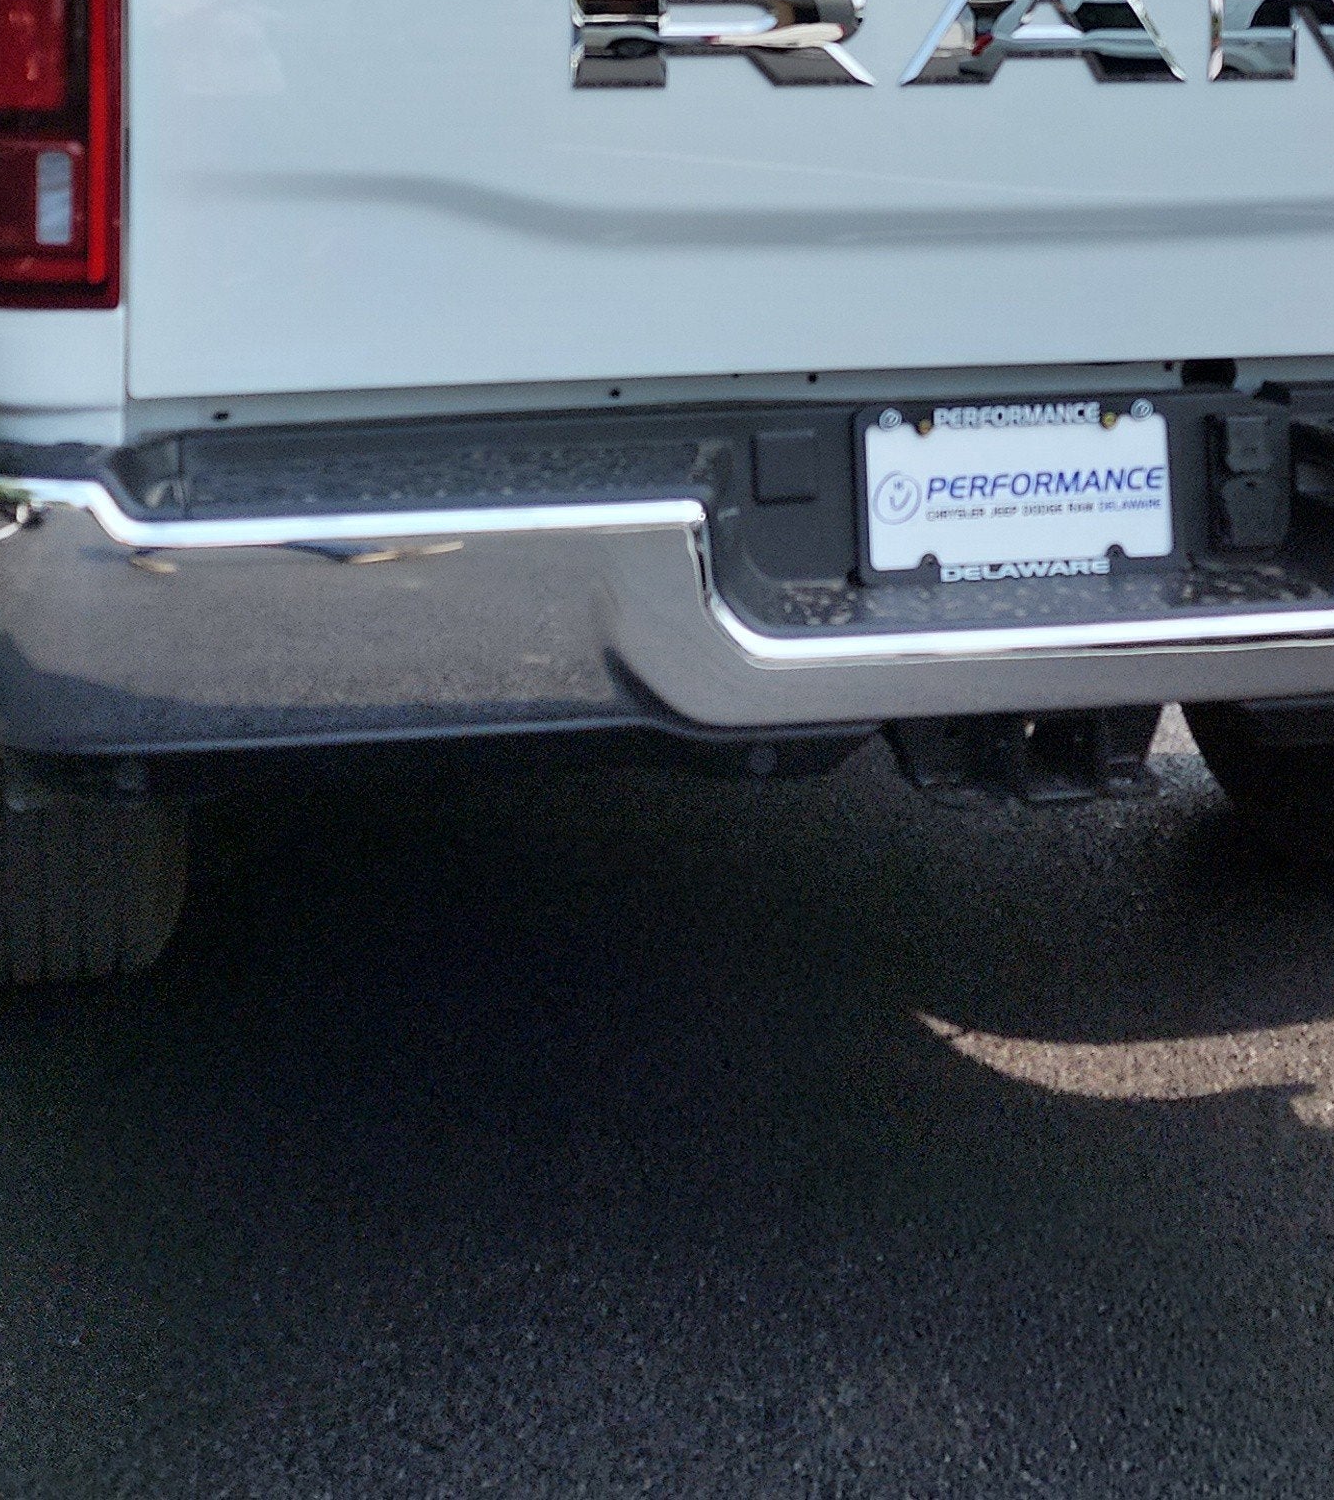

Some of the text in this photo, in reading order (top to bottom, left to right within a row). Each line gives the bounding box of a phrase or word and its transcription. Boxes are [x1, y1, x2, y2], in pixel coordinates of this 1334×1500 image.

[934, 402, 1100, 429] PERFORMANCE
[926, 466, 1165, 503] PERFORMANCE
[941, 558, 1111, 582] DELAWARE
